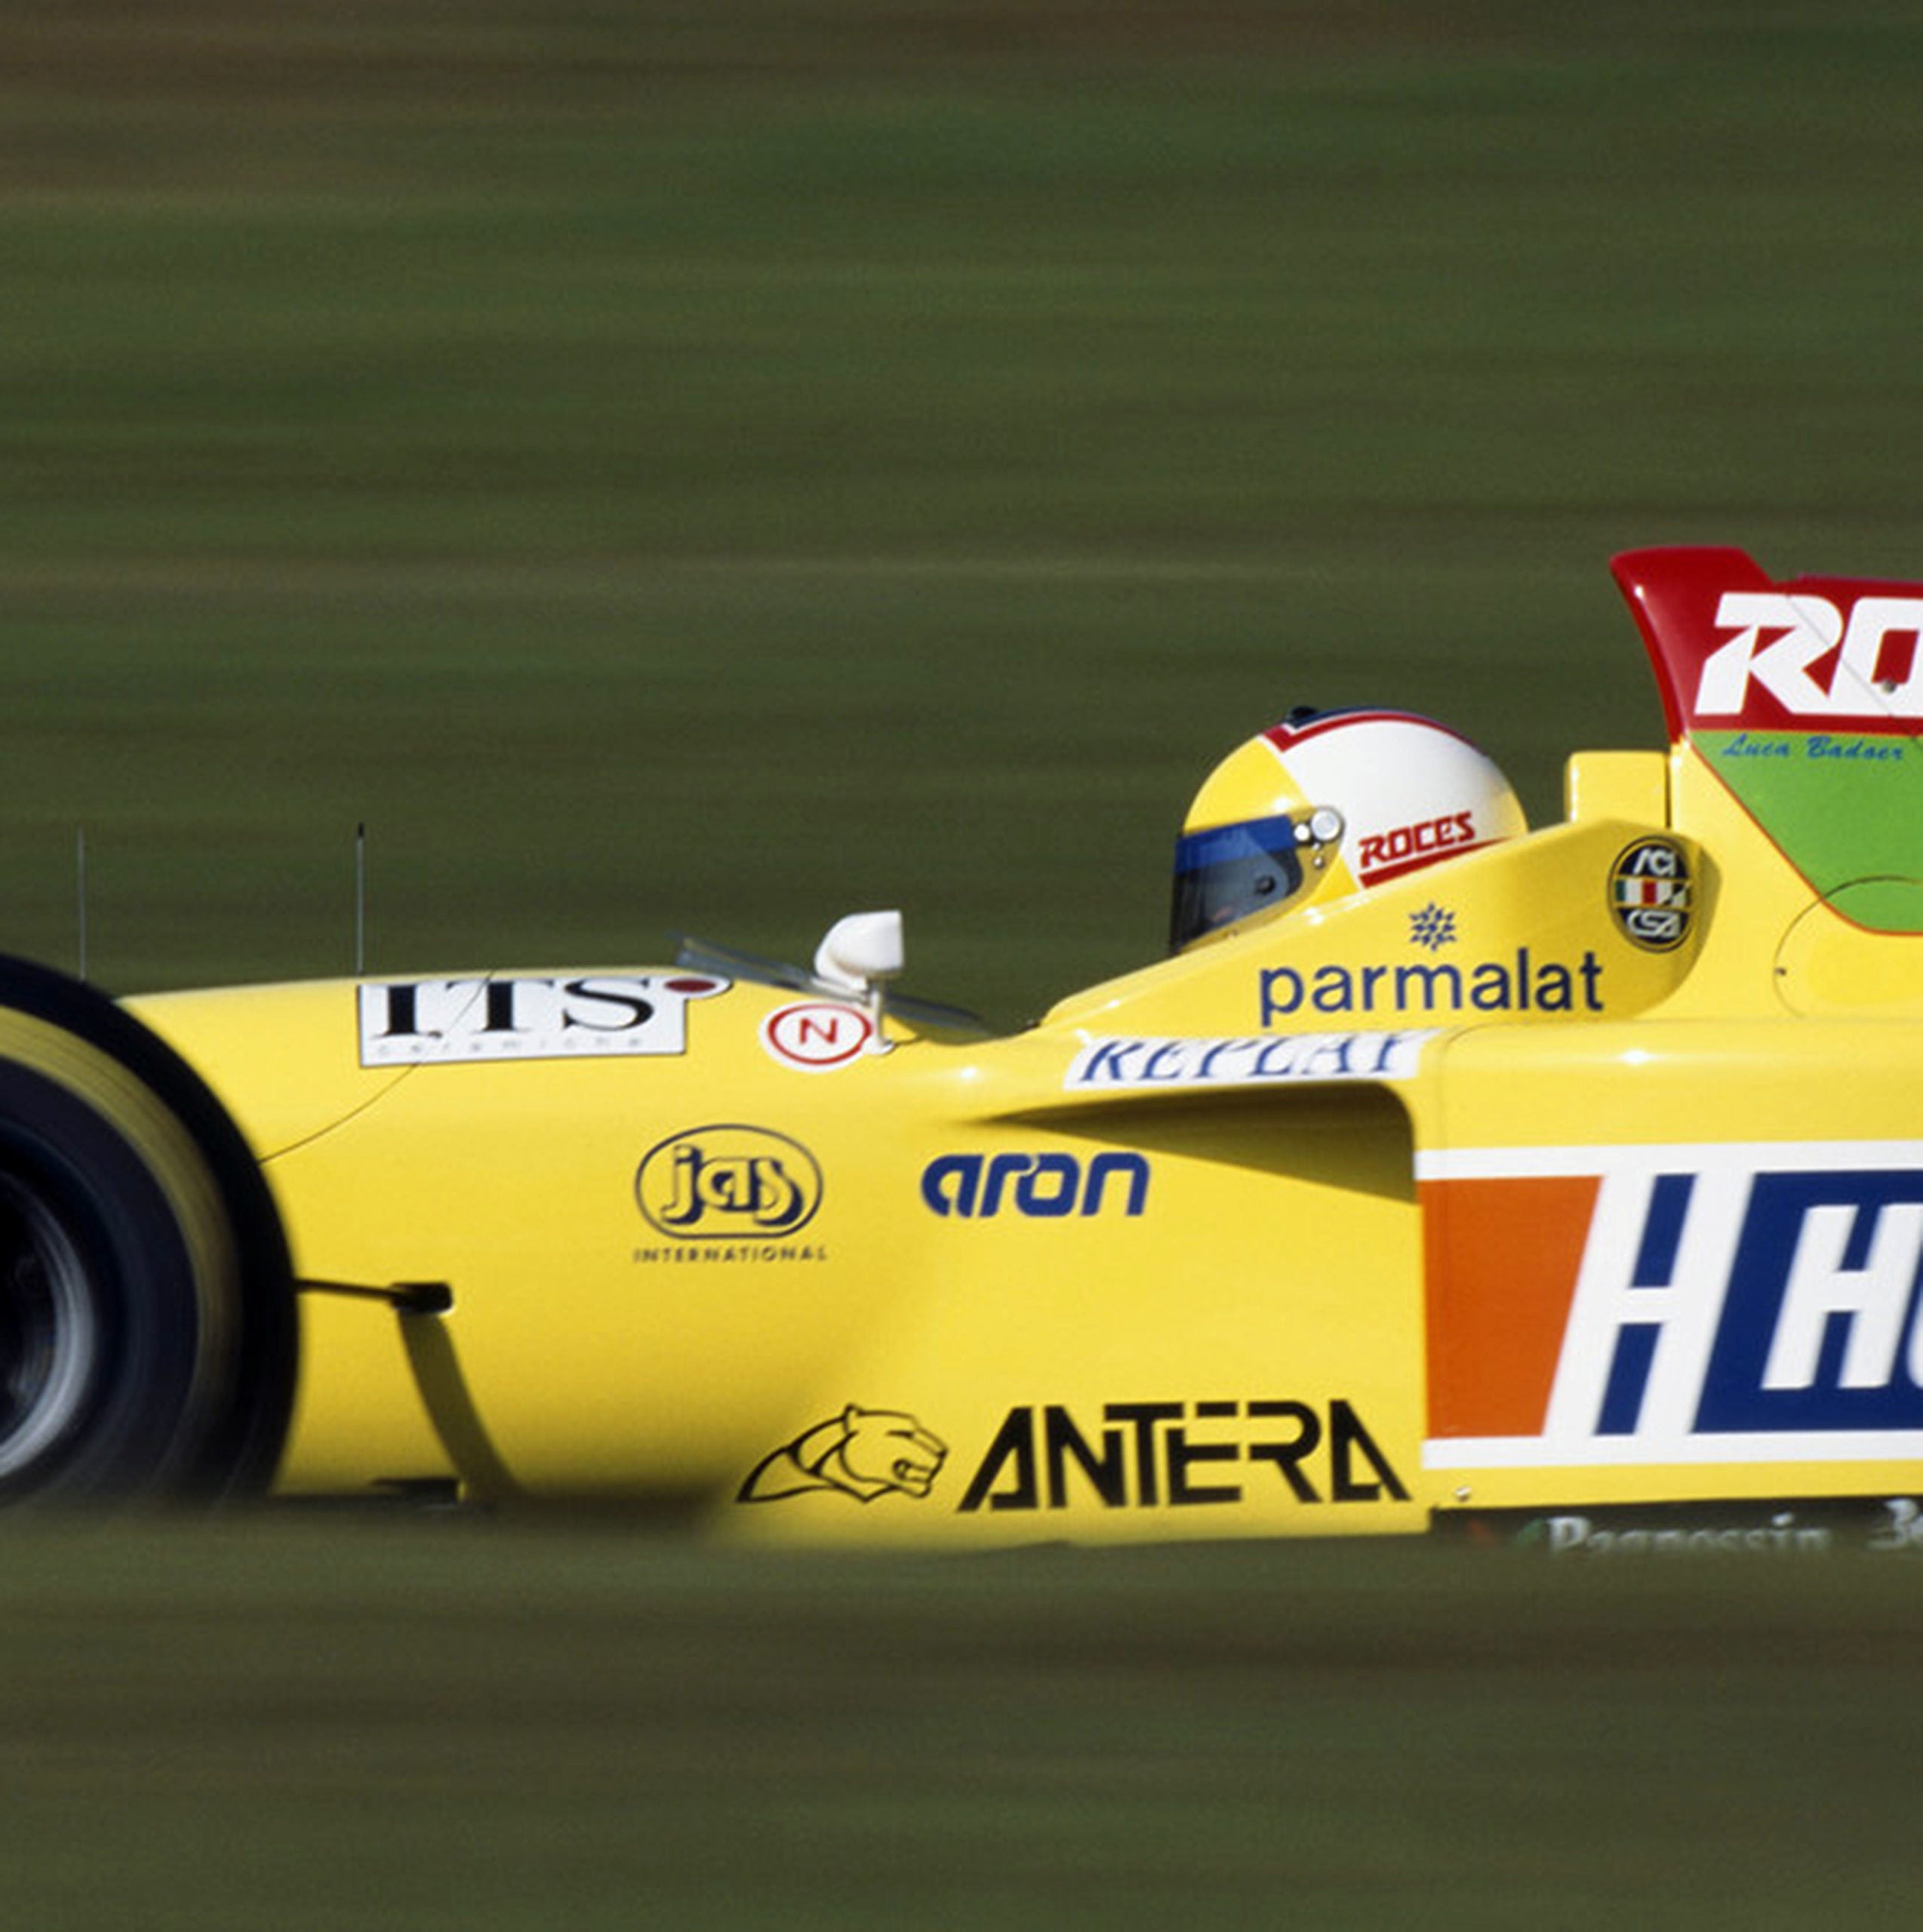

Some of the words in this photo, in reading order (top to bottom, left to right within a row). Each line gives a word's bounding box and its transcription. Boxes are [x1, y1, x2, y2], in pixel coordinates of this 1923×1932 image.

[1721, 733, 1790, 758] Luca
[1358, 810, 1475, 869] ROCES
[1260, 948, 1603, 1027] parmalat
[800, 1018, 837, 1044] N
[660, 1143, 805, 1228] jas
[920, 1152, 1150, 1217] aron
[632, 1246, 828, 1263] INTERNATIONAL
[1761, 1203, 1923, 1390] H
[956, 1399, 1413, 1512] ANTERA
